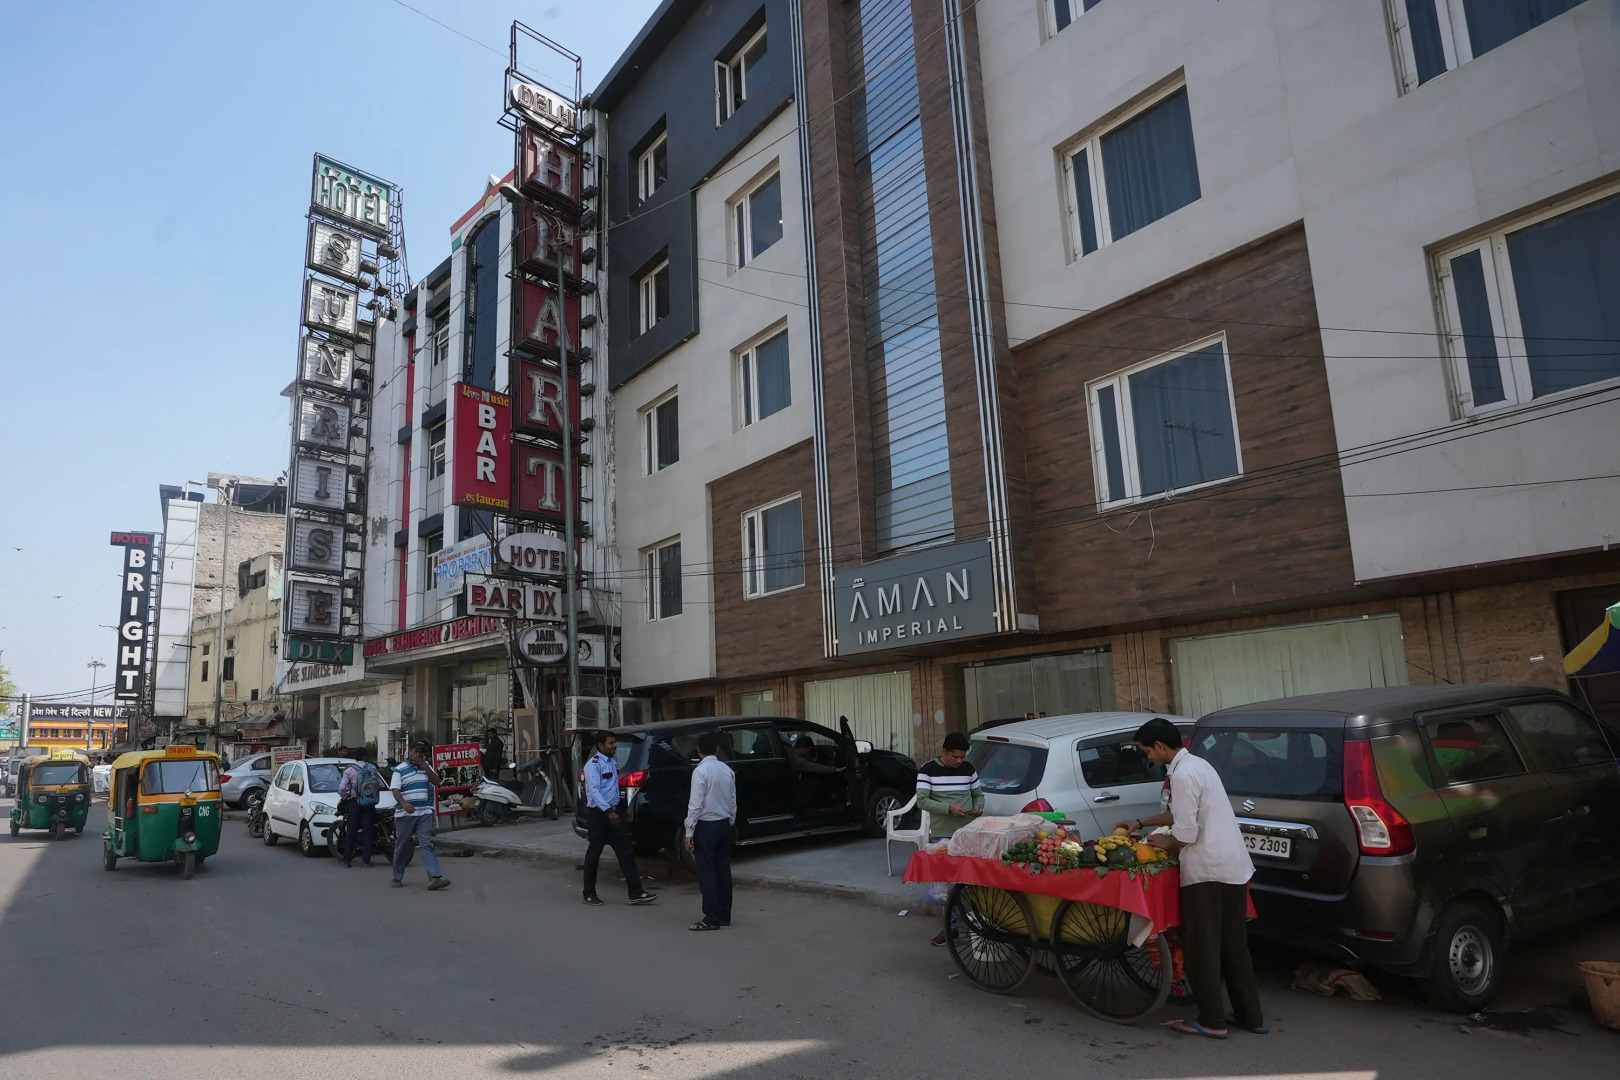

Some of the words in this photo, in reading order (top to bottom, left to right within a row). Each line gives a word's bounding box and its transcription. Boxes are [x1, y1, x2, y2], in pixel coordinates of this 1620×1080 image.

[518, 84, 577, 128] DELHI
[316, 174, 387, 228] HOTEL
[526, 134, 577, 512] HEART
[462, 385, 481, 401] Live
[481, 390, 510, 407] Music
[303, 233, 351, 627] SUNRISE
[475, 402, 498, 484] BAR
[111, 532, 151, 545] HOTEL
[510, 545, 567, 572] HOTEL
[471, 585, 523, 609] BAR
[533, 589, 557, 617] DX
[119, 548, 146, 691] BRIGHT
[451, 616, 482, 639] DELHI
[858, 615, 963, 645] IMPERIAL
[412, 625, 443, 648] HEART
[535, 629, 556, 641] JAIN
[298, 642, 345, 662] DLX
[59, 706, 70, 718] नई
[71, 706, 92, 717] दिल्ली
[93, 707, 113, 718] NEW
[436, 751, 452, 762] NEW
[198, 806, 210, 817] CNG
[1259, 838, 1288, 854] 2309
